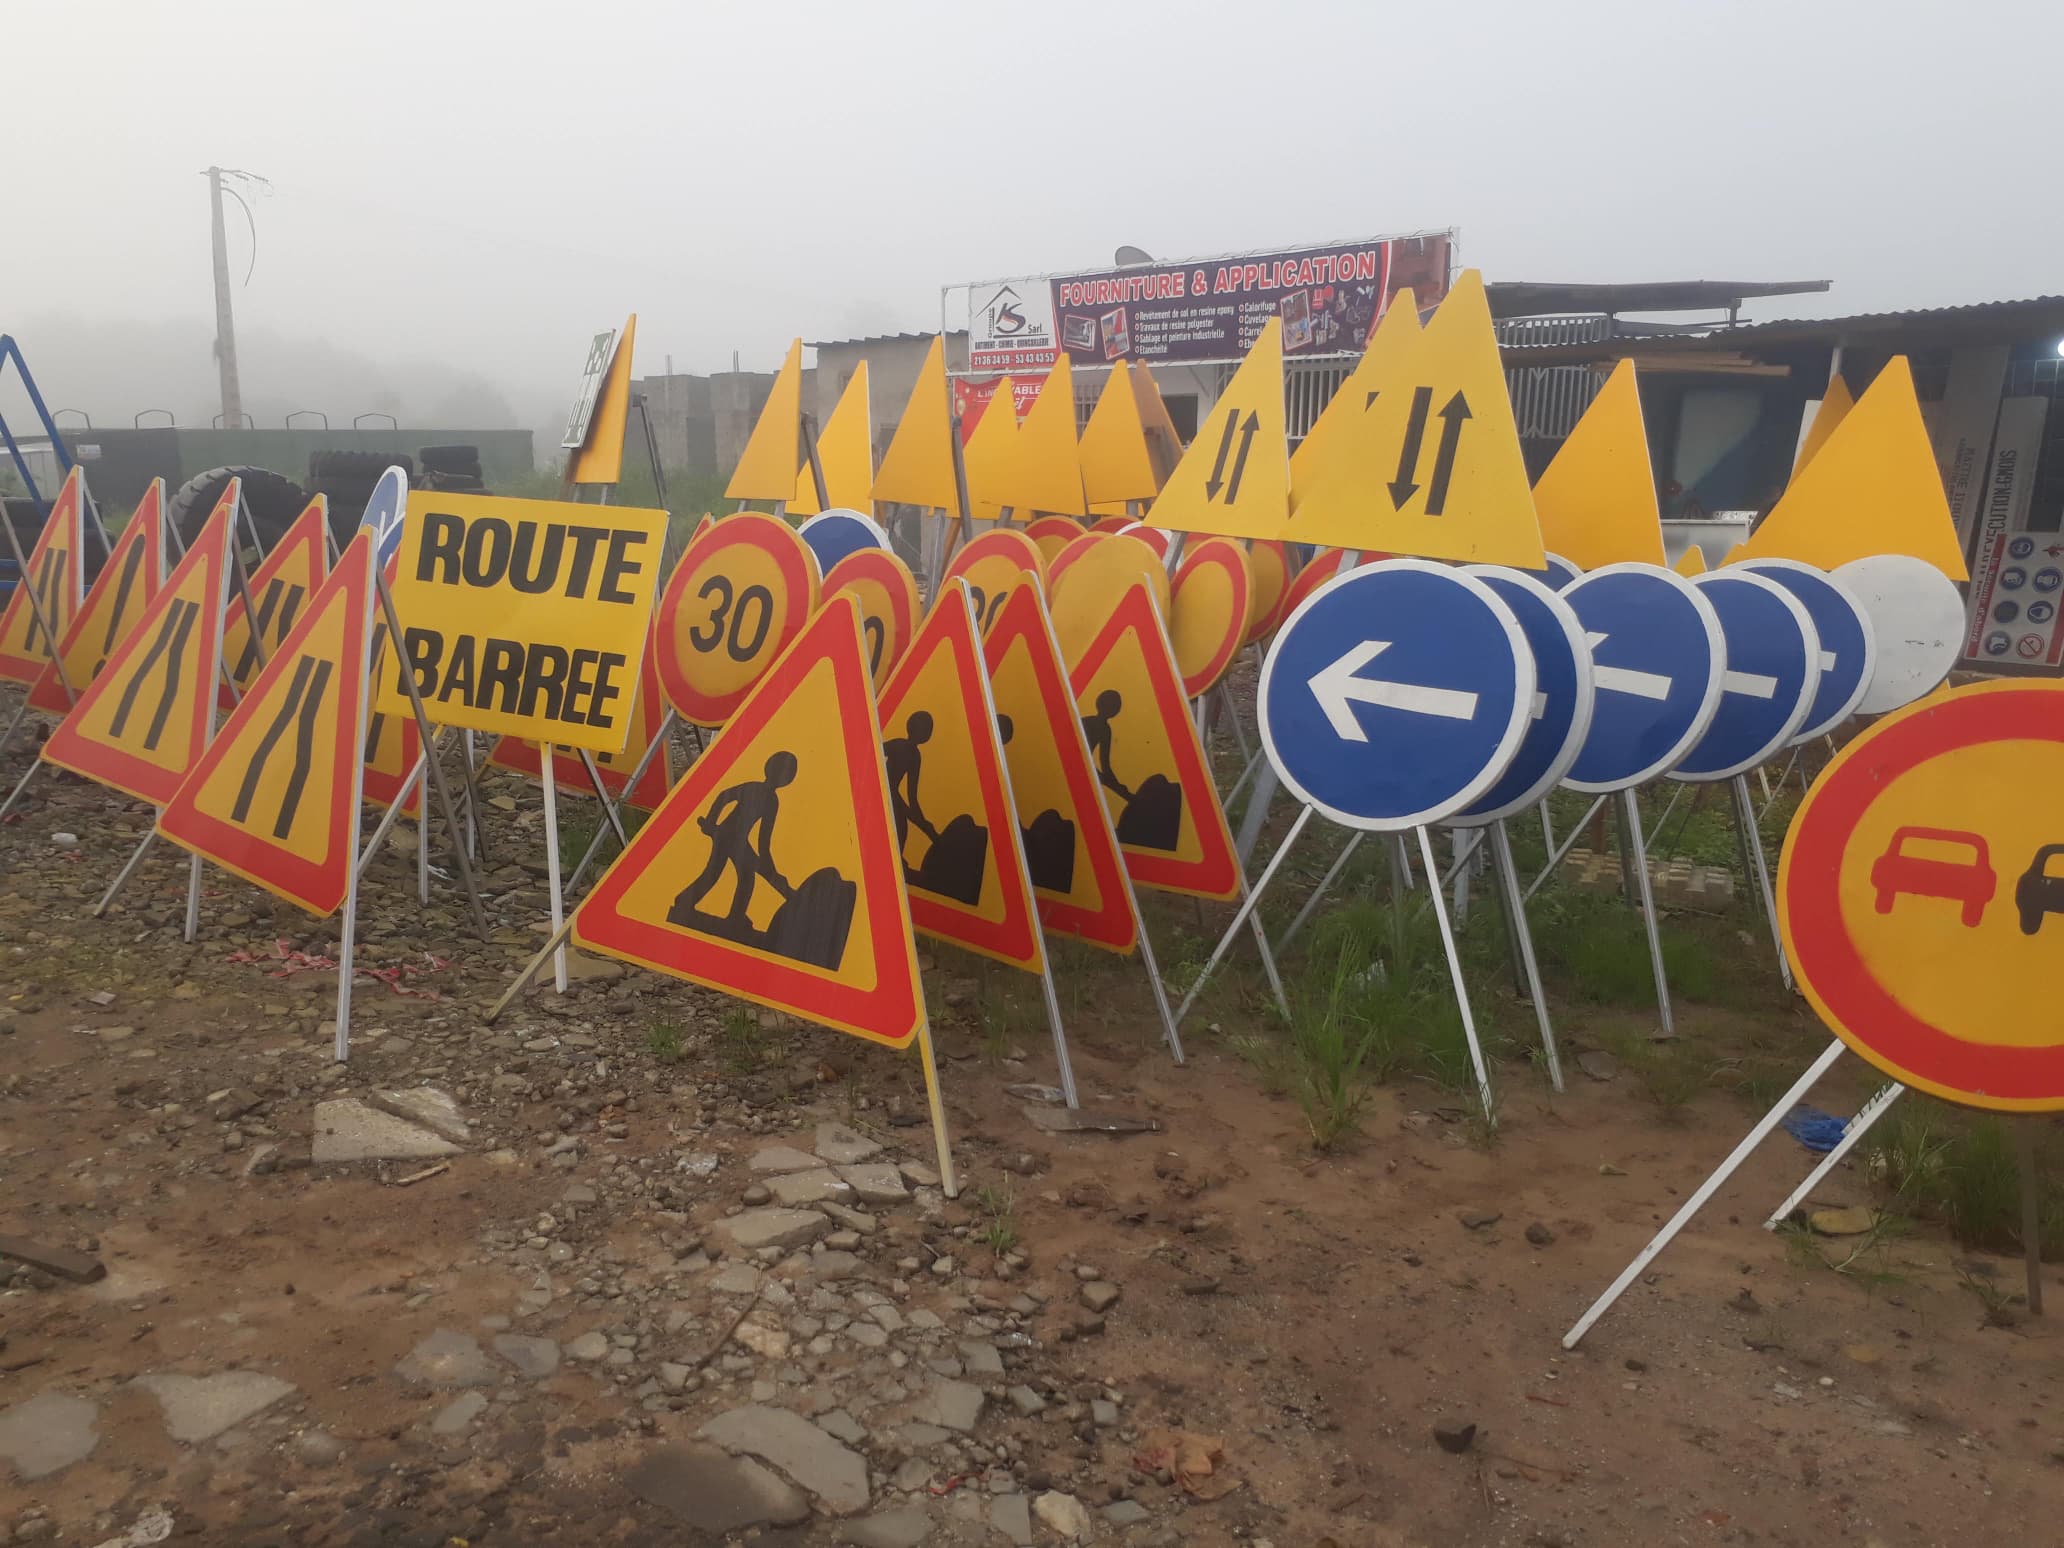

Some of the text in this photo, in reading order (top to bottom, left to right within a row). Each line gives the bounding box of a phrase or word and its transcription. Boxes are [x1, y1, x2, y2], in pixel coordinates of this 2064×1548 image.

[1060, 251, 1376, 307] FOURNITURE & APPLICATION
[1028, 323, 1042, 333] Sarl
[1140, 322, 1160, 332] Travaux
[1162, 321, 1168, 330] de
[1187, 319, 1214, 330] polyester
[1172, 308, 1178, 318] de
[1180, 307, 1189, 317] sol
[1190, 309, 1197, 317] en
[1140, 328, 1225, 344] Sablage et peinture industrielle
[416, 512, 648, 605] ROUTE
[689, 575, 774, 662] 30
[397, 627, 626, 729] BARREE
